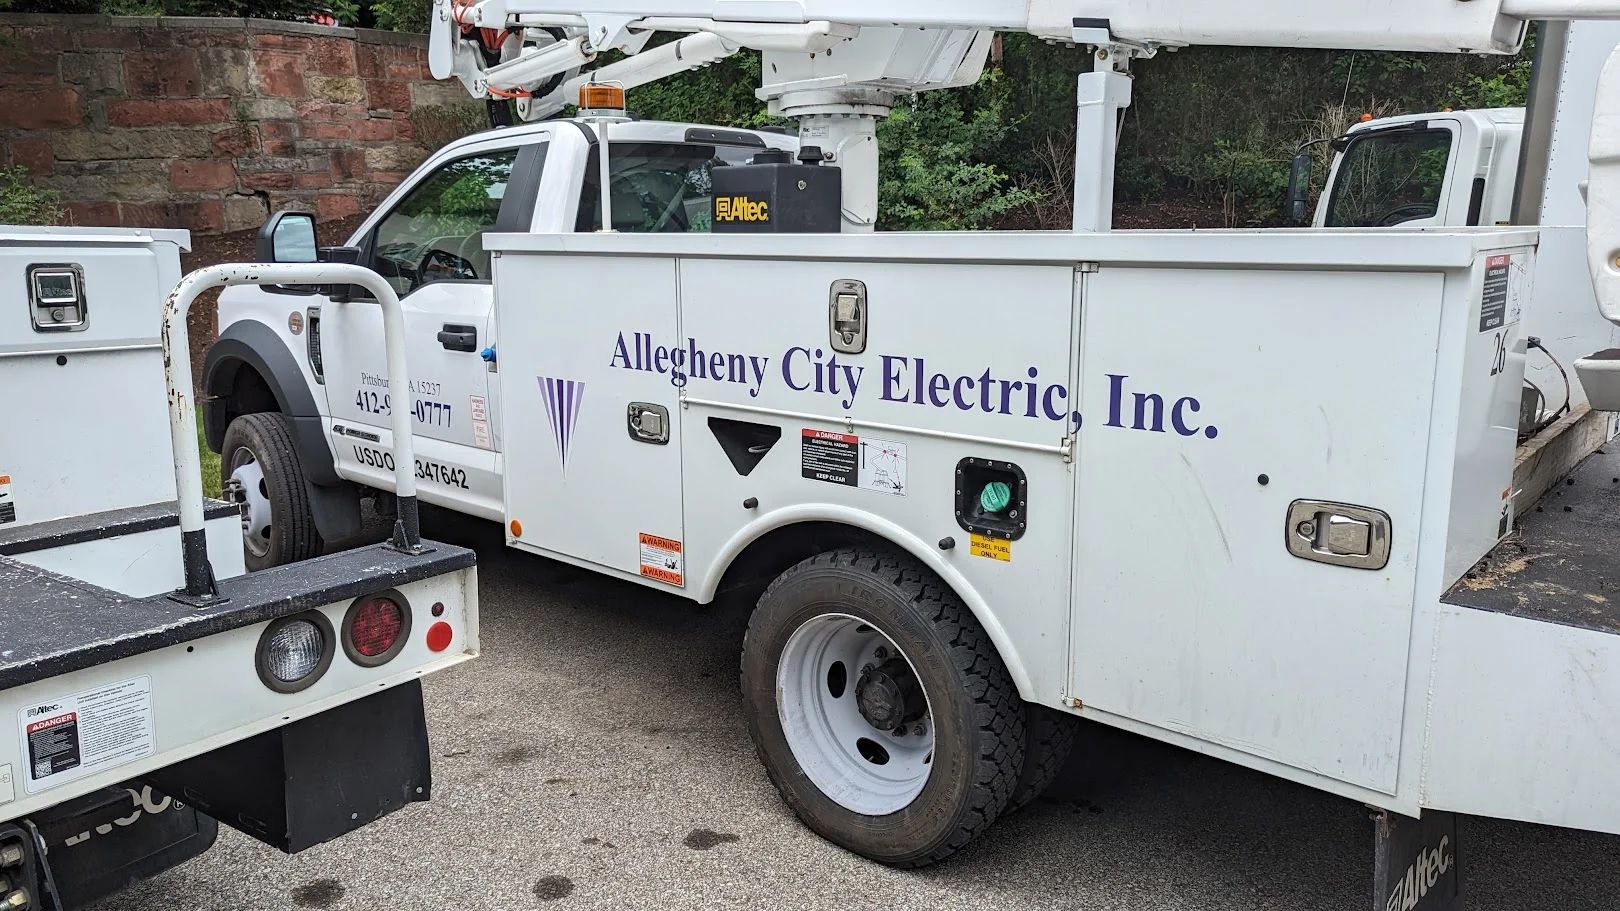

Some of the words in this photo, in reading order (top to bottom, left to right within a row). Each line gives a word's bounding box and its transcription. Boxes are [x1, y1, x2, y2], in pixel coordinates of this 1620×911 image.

[731, 196, 768, 221] Altec
[1490, 329, 1508, 376] 26
[361, 372, 389, 388] Pittsbur
[408, 380, 416, 393] A
[417, 381, 441, 397] 15237
[609, 330, 769, 398] Allegheny
[781, 346, 865, 410] City
[878, 354, 1083, 434] Electric,
[1102, 373, 1219, 440] Inc.
[355, 389, 451, 428] 412-9-0777
[820, 432, 843, 440] DANGER
[353, 445, 395, 472] USDO
[414, 459, 470, 490] 347642
[829, 475, 846, 483] CLEAR
[647, 536, 679, 552] WARNING
[971, 541, 992, 550] DIESEL
[994, 545, 1010, 553] FUEL
[648, 566, 680, 583] WARNING
[37, 704, 59, 715] Altec
[39, 714, 72, 729] DANGER
[1401, 834, 1449, 911] Altec
